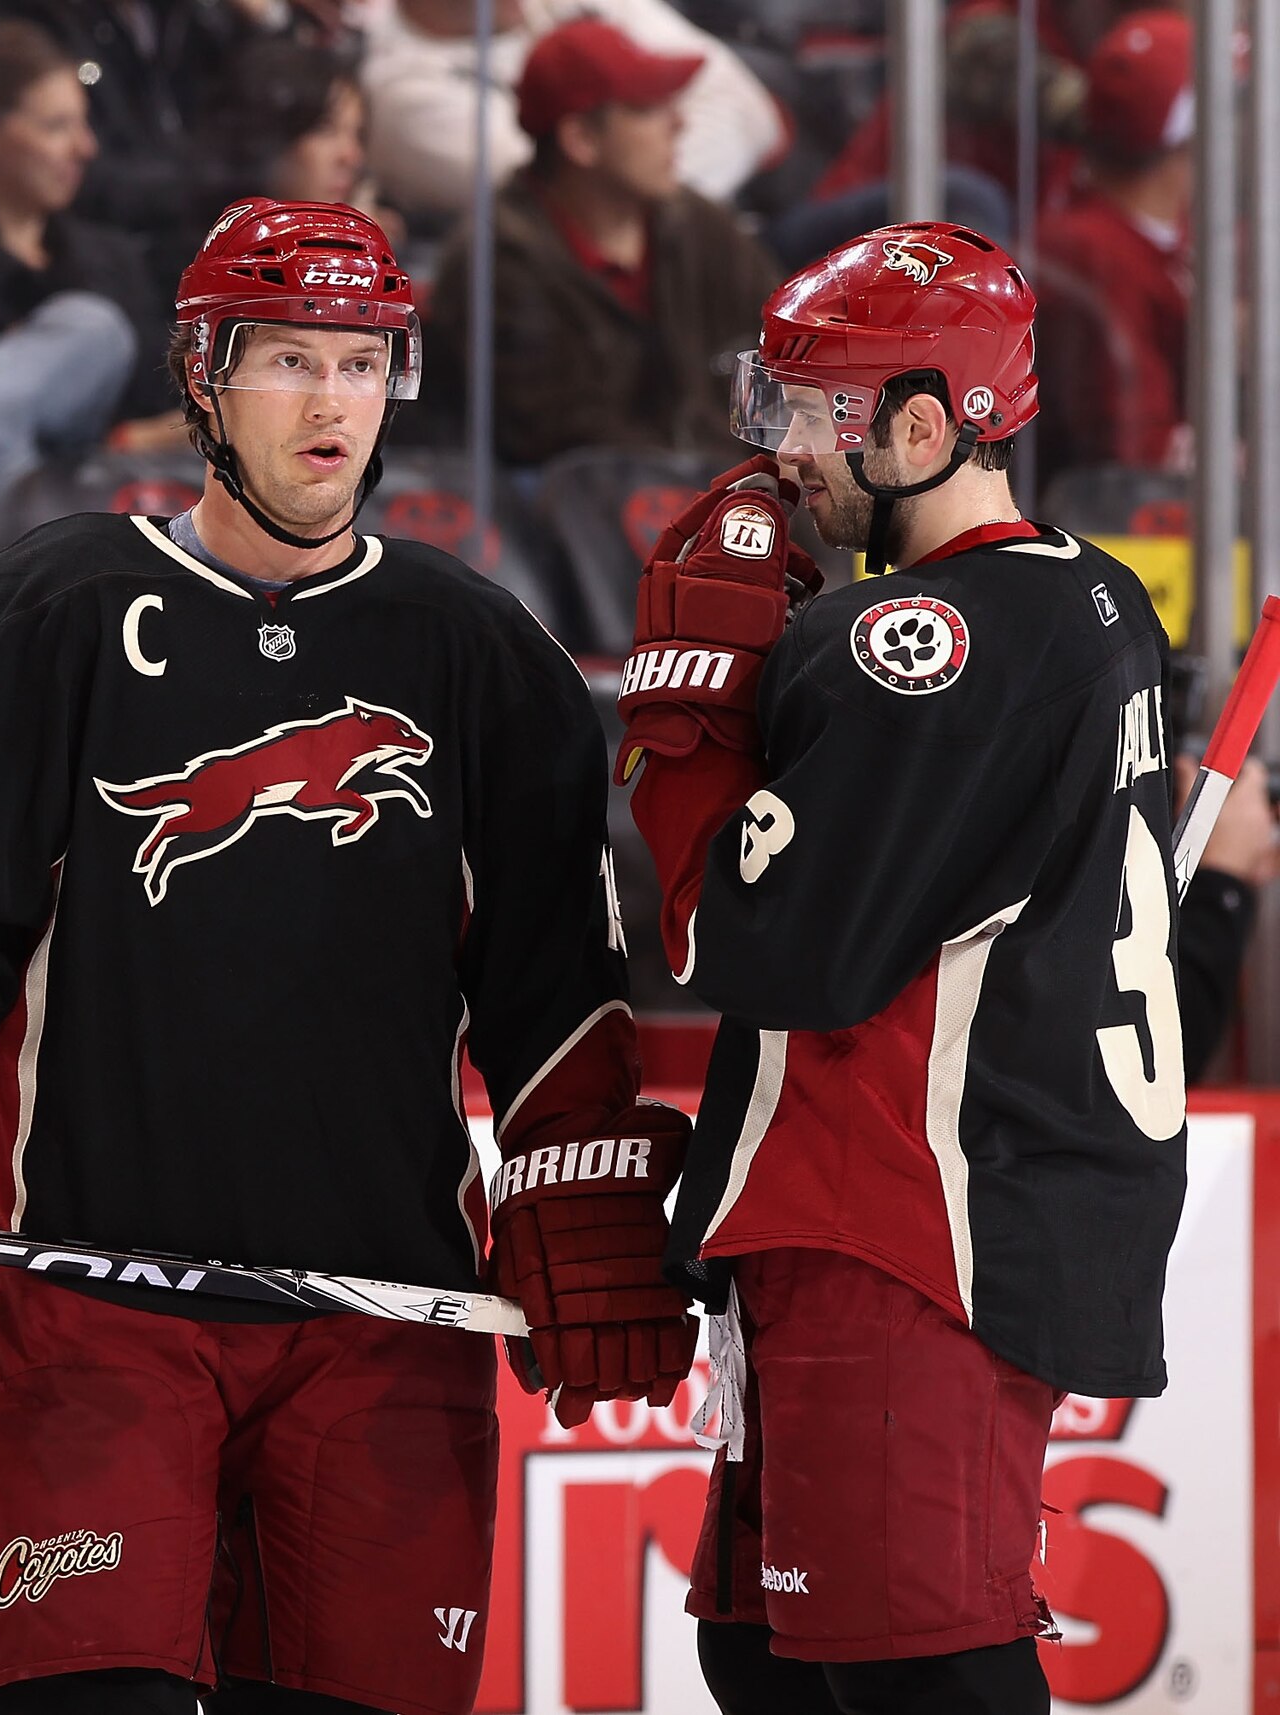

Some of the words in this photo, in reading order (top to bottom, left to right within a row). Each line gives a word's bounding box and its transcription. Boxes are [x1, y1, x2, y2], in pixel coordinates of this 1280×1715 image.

[303, 271, 372, 288] CCM
[969, 392, 989, 413] JN
[122, 594, 168, 677] C
[876, 599, 966, 647] PHOENIX
[617, 649, 735, 702] WAR
[855, 634, 949, 690] COYOTES
[1095, 803, 1187, 1142] 3
[34, 1529, 85, 1550] PHOENIX
